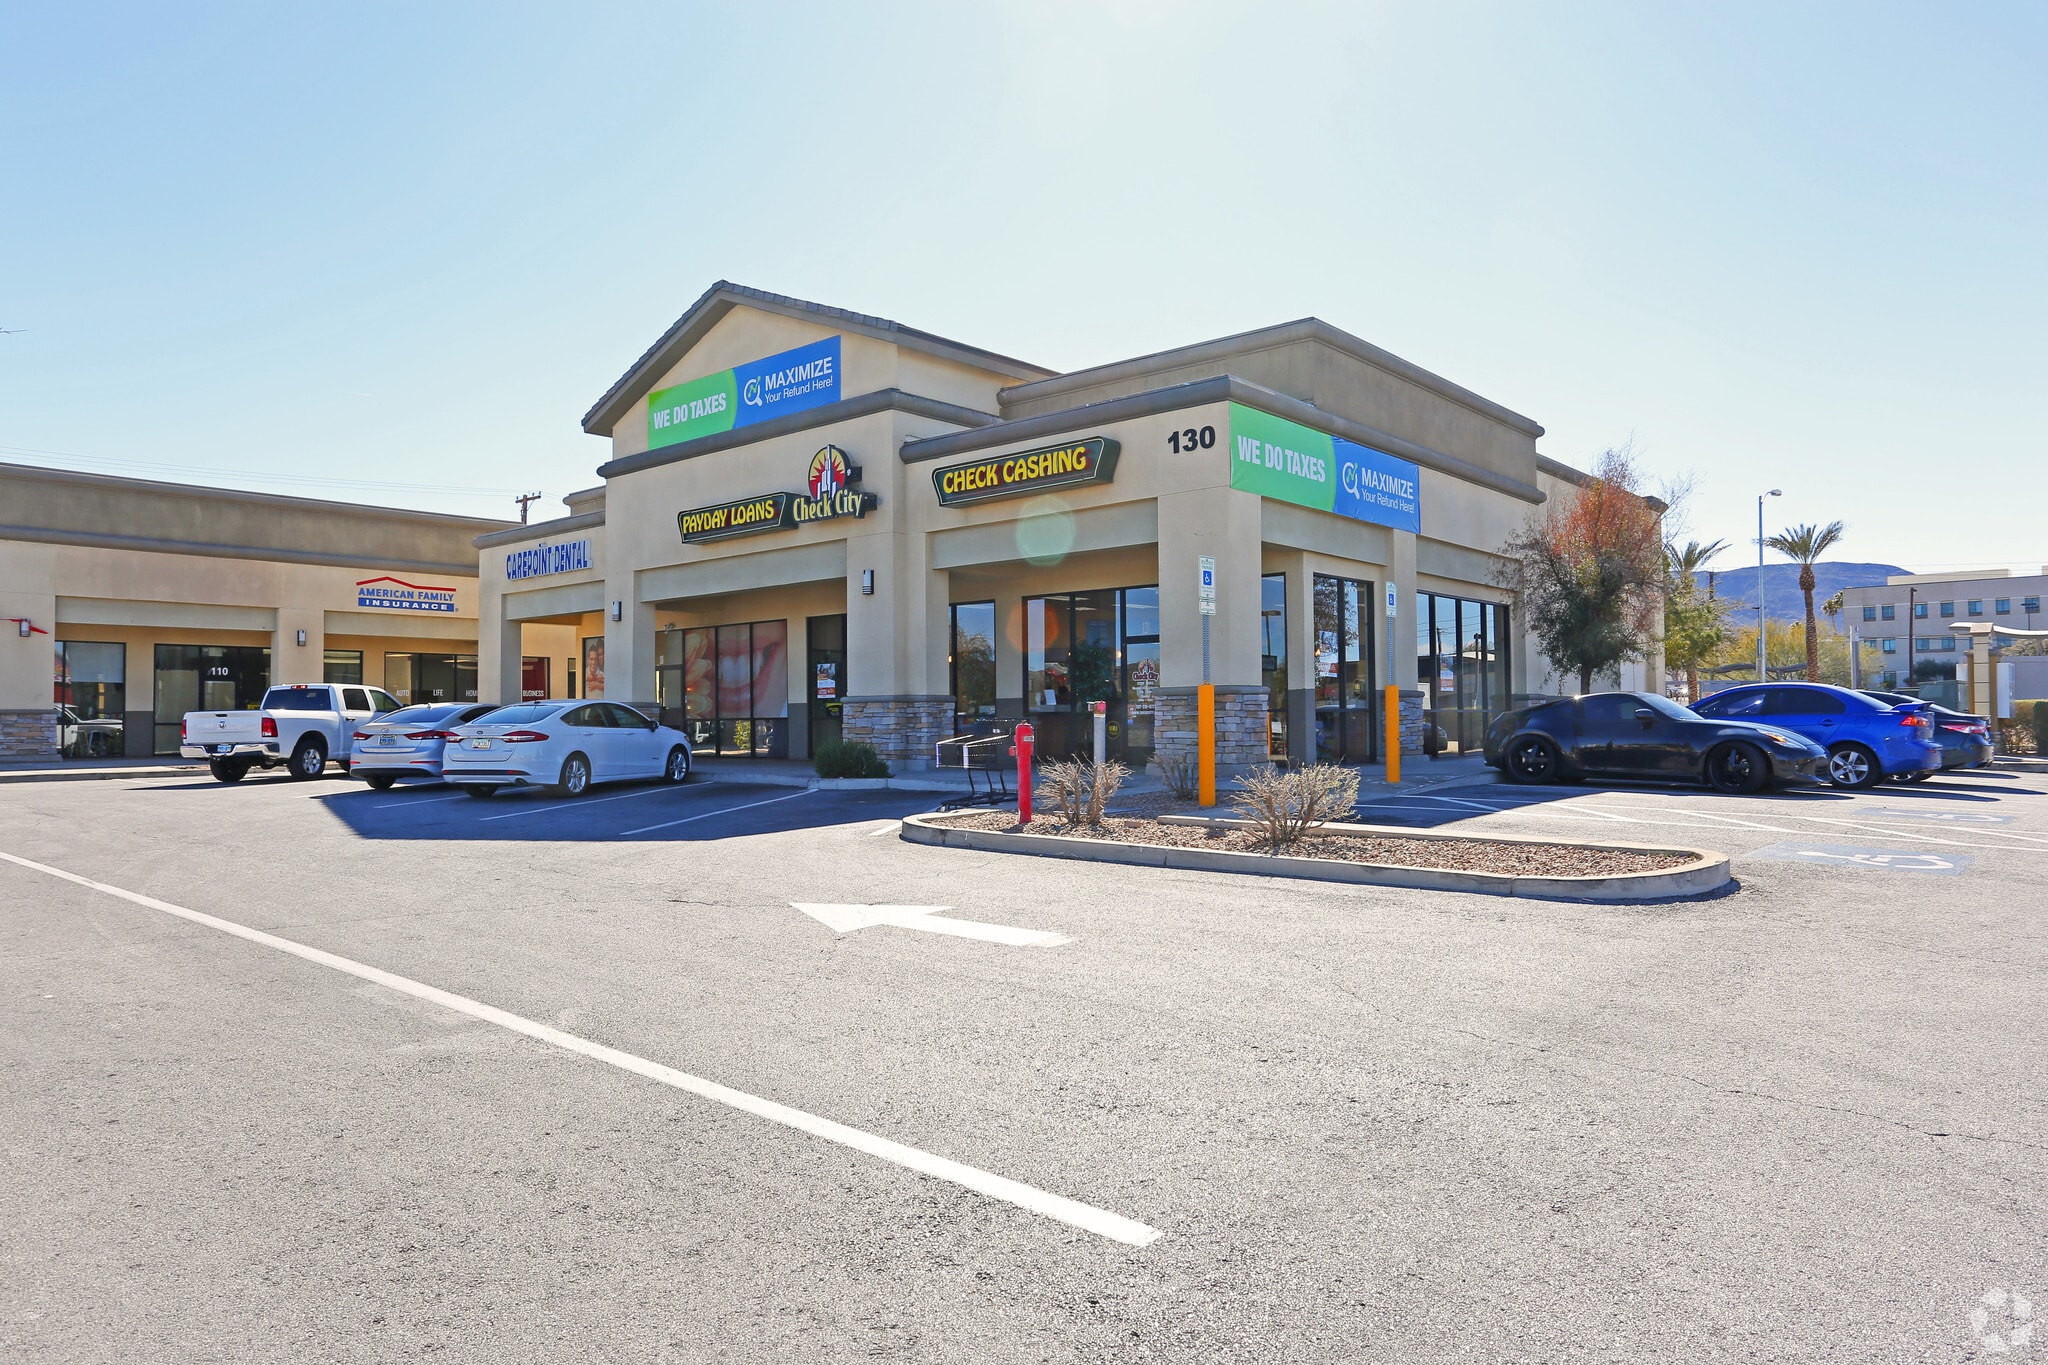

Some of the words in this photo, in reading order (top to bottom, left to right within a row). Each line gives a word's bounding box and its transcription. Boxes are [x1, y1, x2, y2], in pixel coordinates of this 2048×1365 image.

[764, 391, 781, 404] Your
[783, 384, 810, 399] Refund
[812, 376, 833, 391] Here!
[765, 356, 833, 391] MAXIMIZE
[653, 409, 670, 430] WE
[673, 404, 688, 424] DO
[690, 392, 727, 419] TAXES
[1167, 425, 1216, 454] 130
[943, 463, 998, 494] CHECK
[1002, 446, 1087, 483] CASHING
[1237, 435, 1261, 465] WE
[1264, 443, 1283, 471] DO
[1285, 449, 1326, 483] TAXES
[1361, 467, 1414, 500] MAXIMIZE
[683, 509, 728, 534] PAYDAY
[731, 499, 775, 525] LOANS
[793, 493, 832, 522] Check
[835, 489, 862, 516] City
[1361, 488, 1376, 504] Your
[1377, 492, 1398, 510] Refund
[1399, 498, 1415, 514] Here!
[554, 540, 588, 573] DENTAL
[358, 587, 415, 599] AMERICAN
[418, 591, 455, 602] FAMILY
[365, 599, 448, 611] INSURANCE
[211, 667, 229, 676] 110
[396, 689, 410, 697] AUTO
[432, 688, 444, 697] LIFE
[465, 689, 478, 697] HOM
[522, 689, 545, 697] BUSINESS
